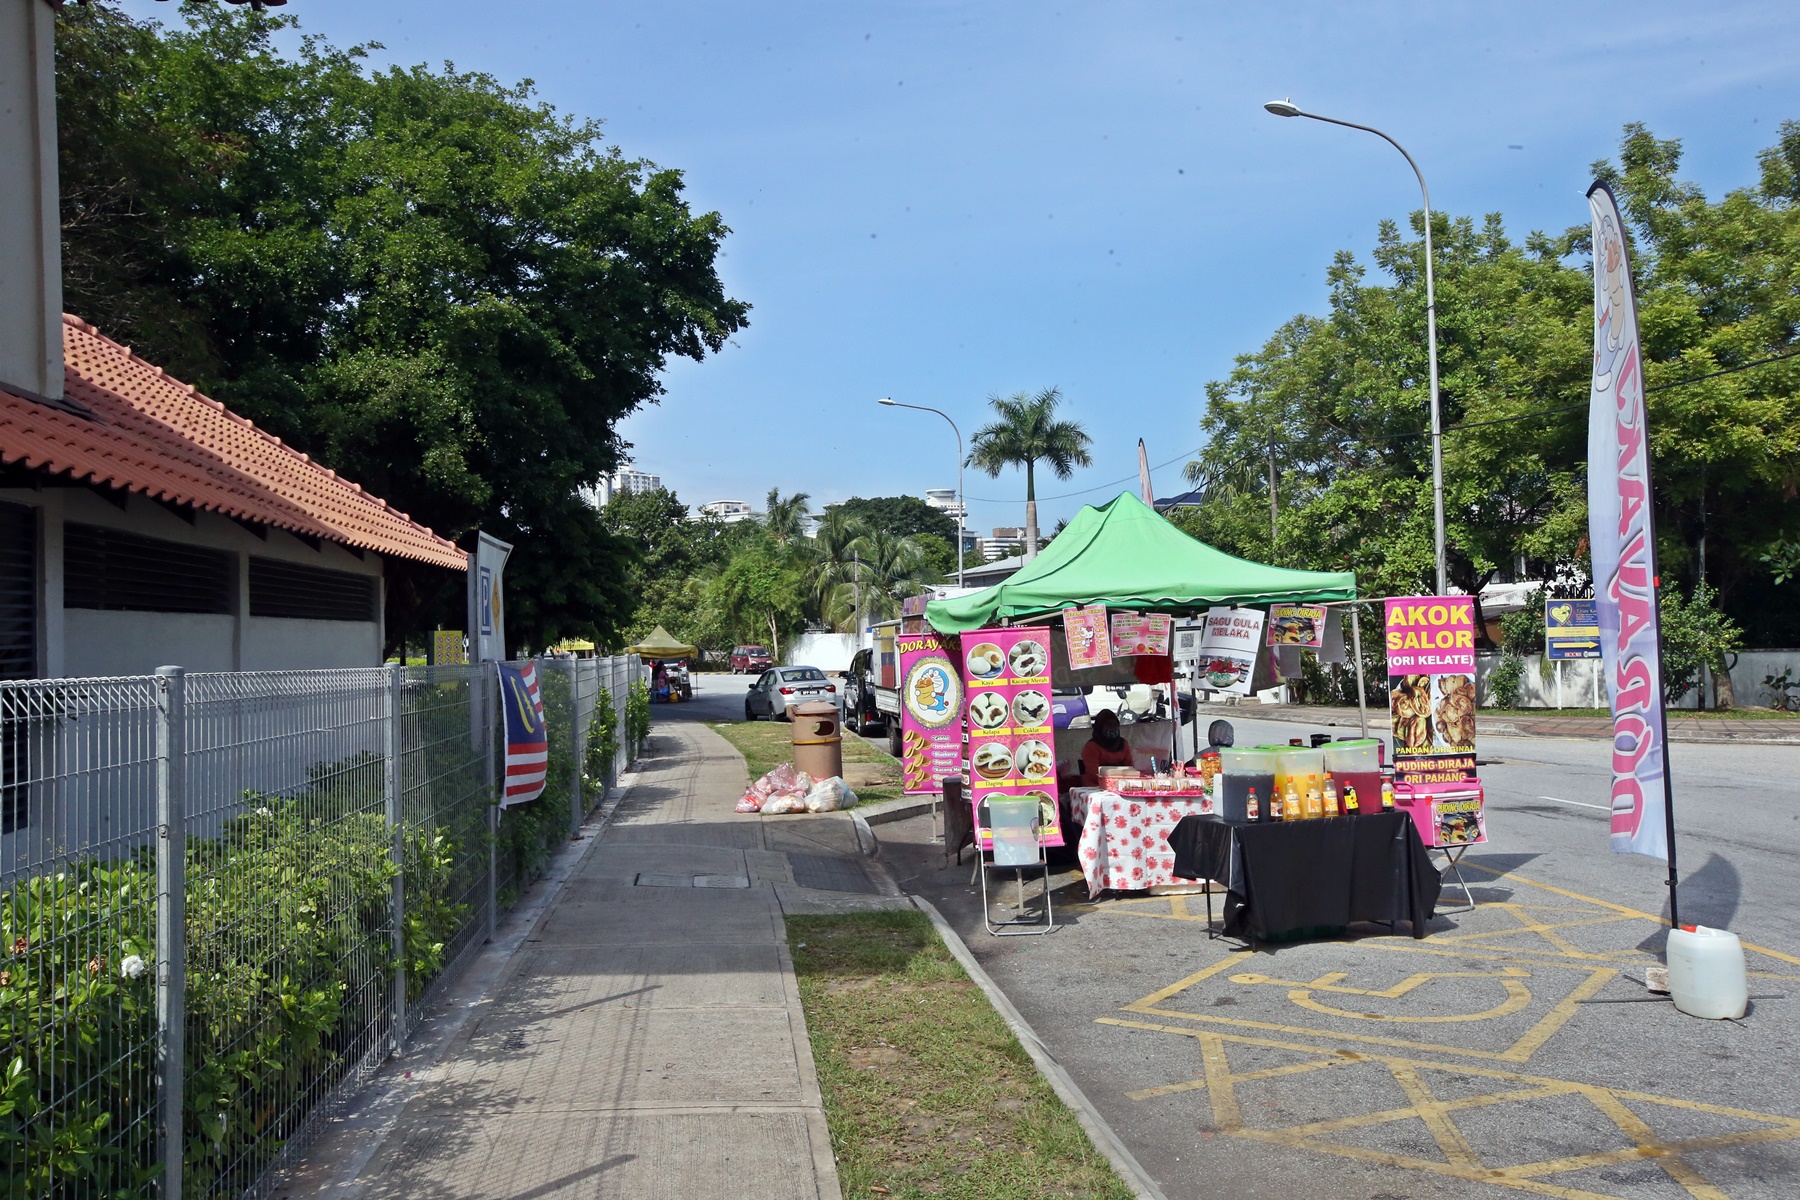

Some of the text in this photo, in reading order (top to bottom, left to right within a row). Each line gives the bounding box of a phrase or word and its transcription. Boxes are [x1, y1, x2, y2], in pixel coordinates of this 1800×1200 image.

[1275, 607, 1321, 618] PUDING DIRAJA
[1387, 605, 1471, 627] AKOK
[1208, 617, 1260, 629] SAGU GULA
[1212, 628, 1250, 639] MELAKA
[1387, 630, 1473, 650] SALOR
[1388, 655, 1474, 668] (ORI KELATE)
[1396, 759, 1474, 772] PUDING DIRAJA
[1404, 773, 1467, 783] ORI PAHANG
[1437, 801, 1480, 813] PUDING DIRAJA
